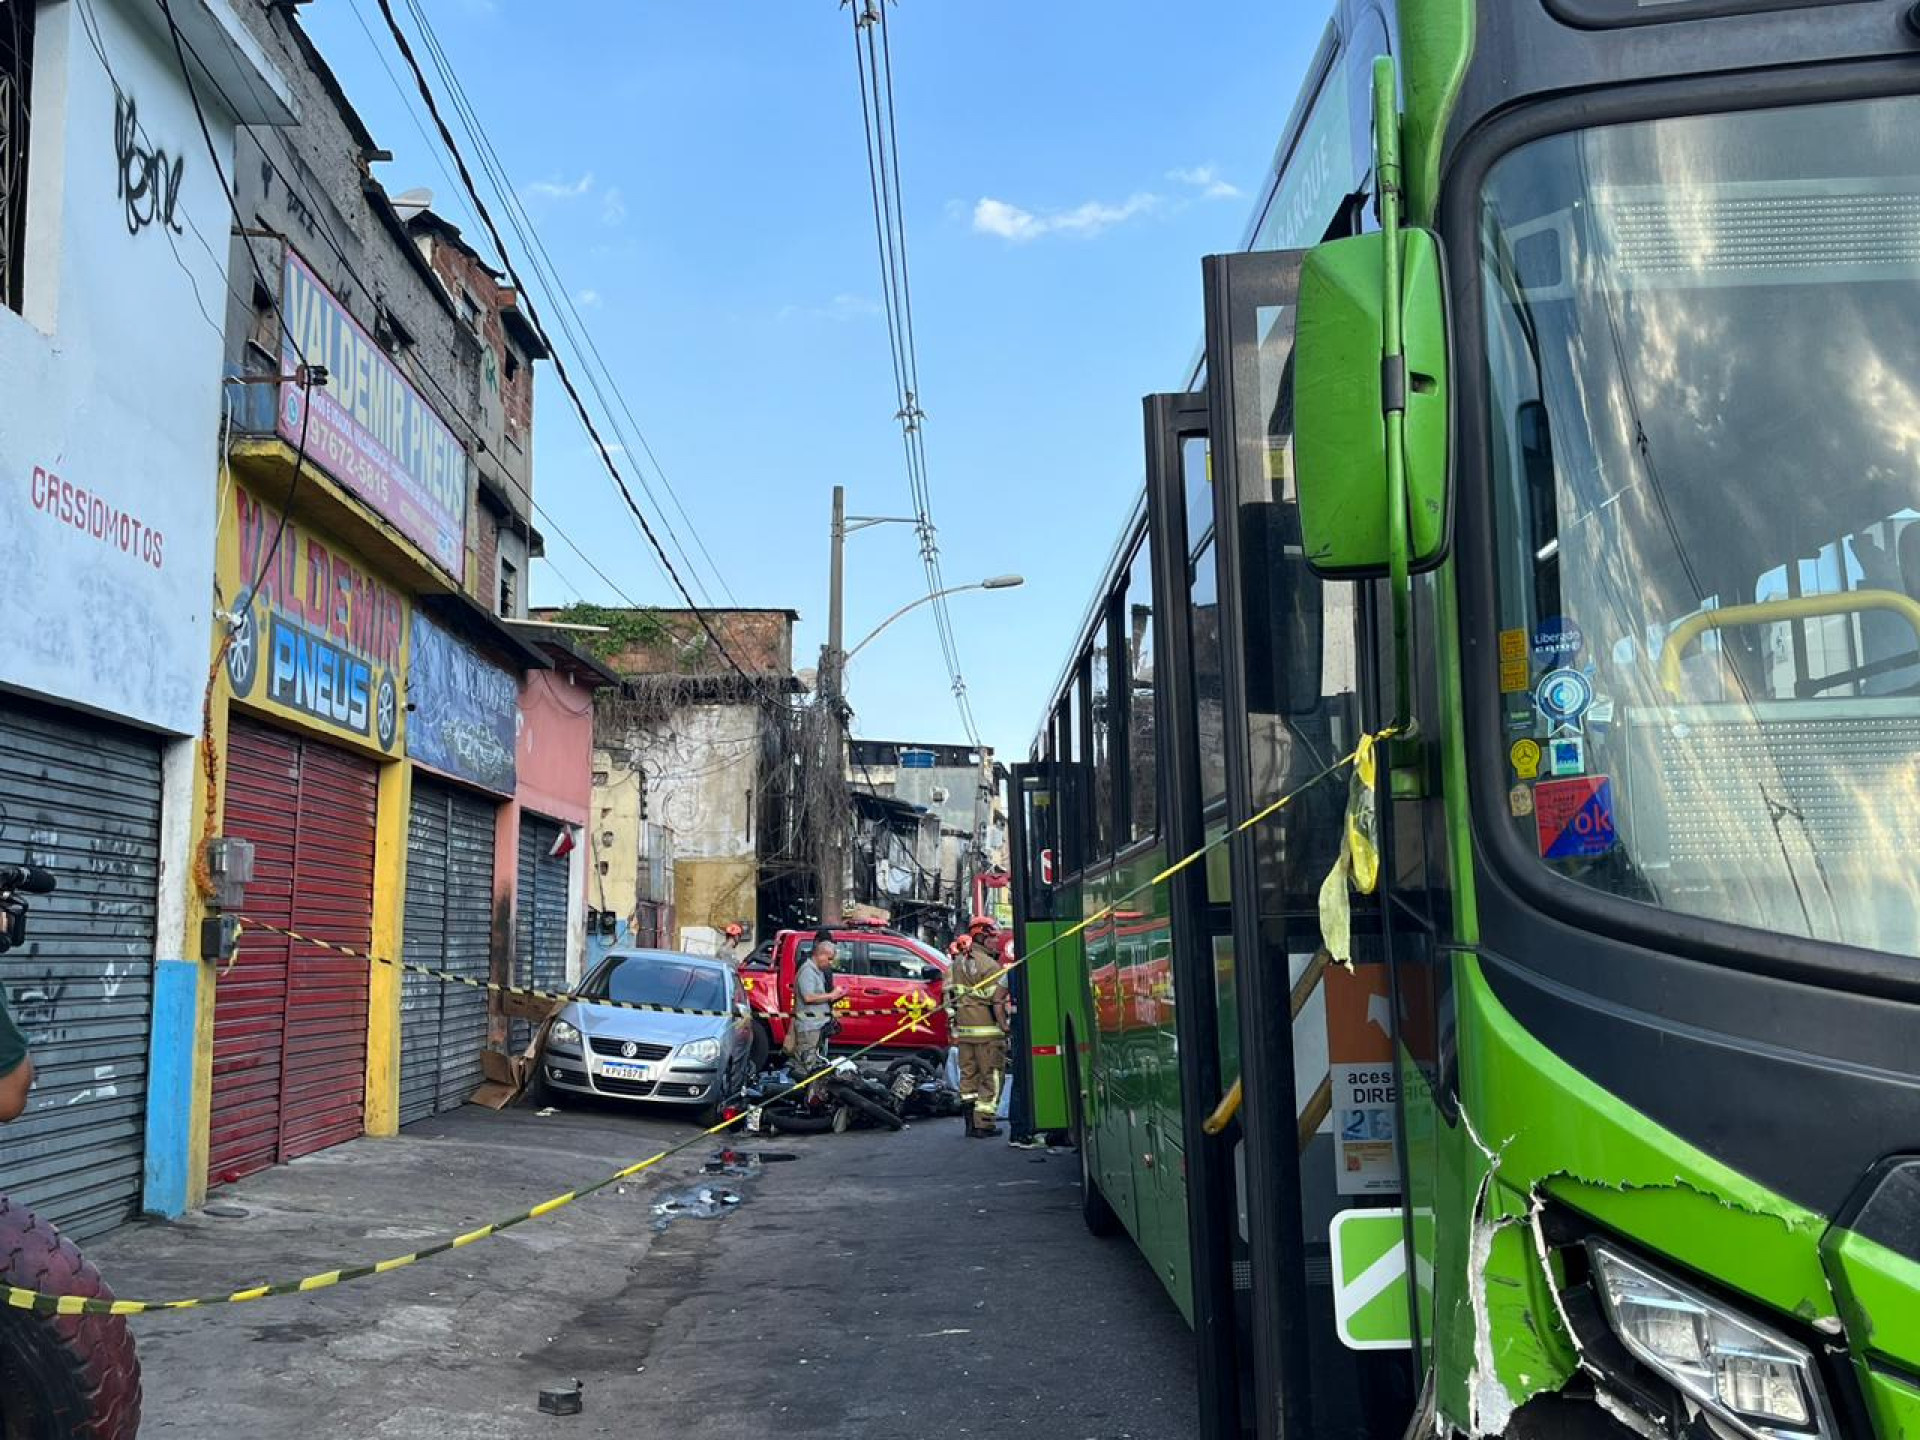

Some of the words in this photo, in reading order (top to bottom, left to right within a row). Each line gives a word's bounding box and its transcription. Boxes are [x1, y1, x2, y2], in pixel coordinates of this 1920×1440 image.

[290, 262, 406, 466] VALDEMIR
[410, 396, 465, 524] PNEUS
[309, 415, 389, 503] 97672-5815
[237, 485, 400, 671] VALDEMIR
[273, 623, 368, 730] PNEUS
[1574, 803, 1613, 835] ok
